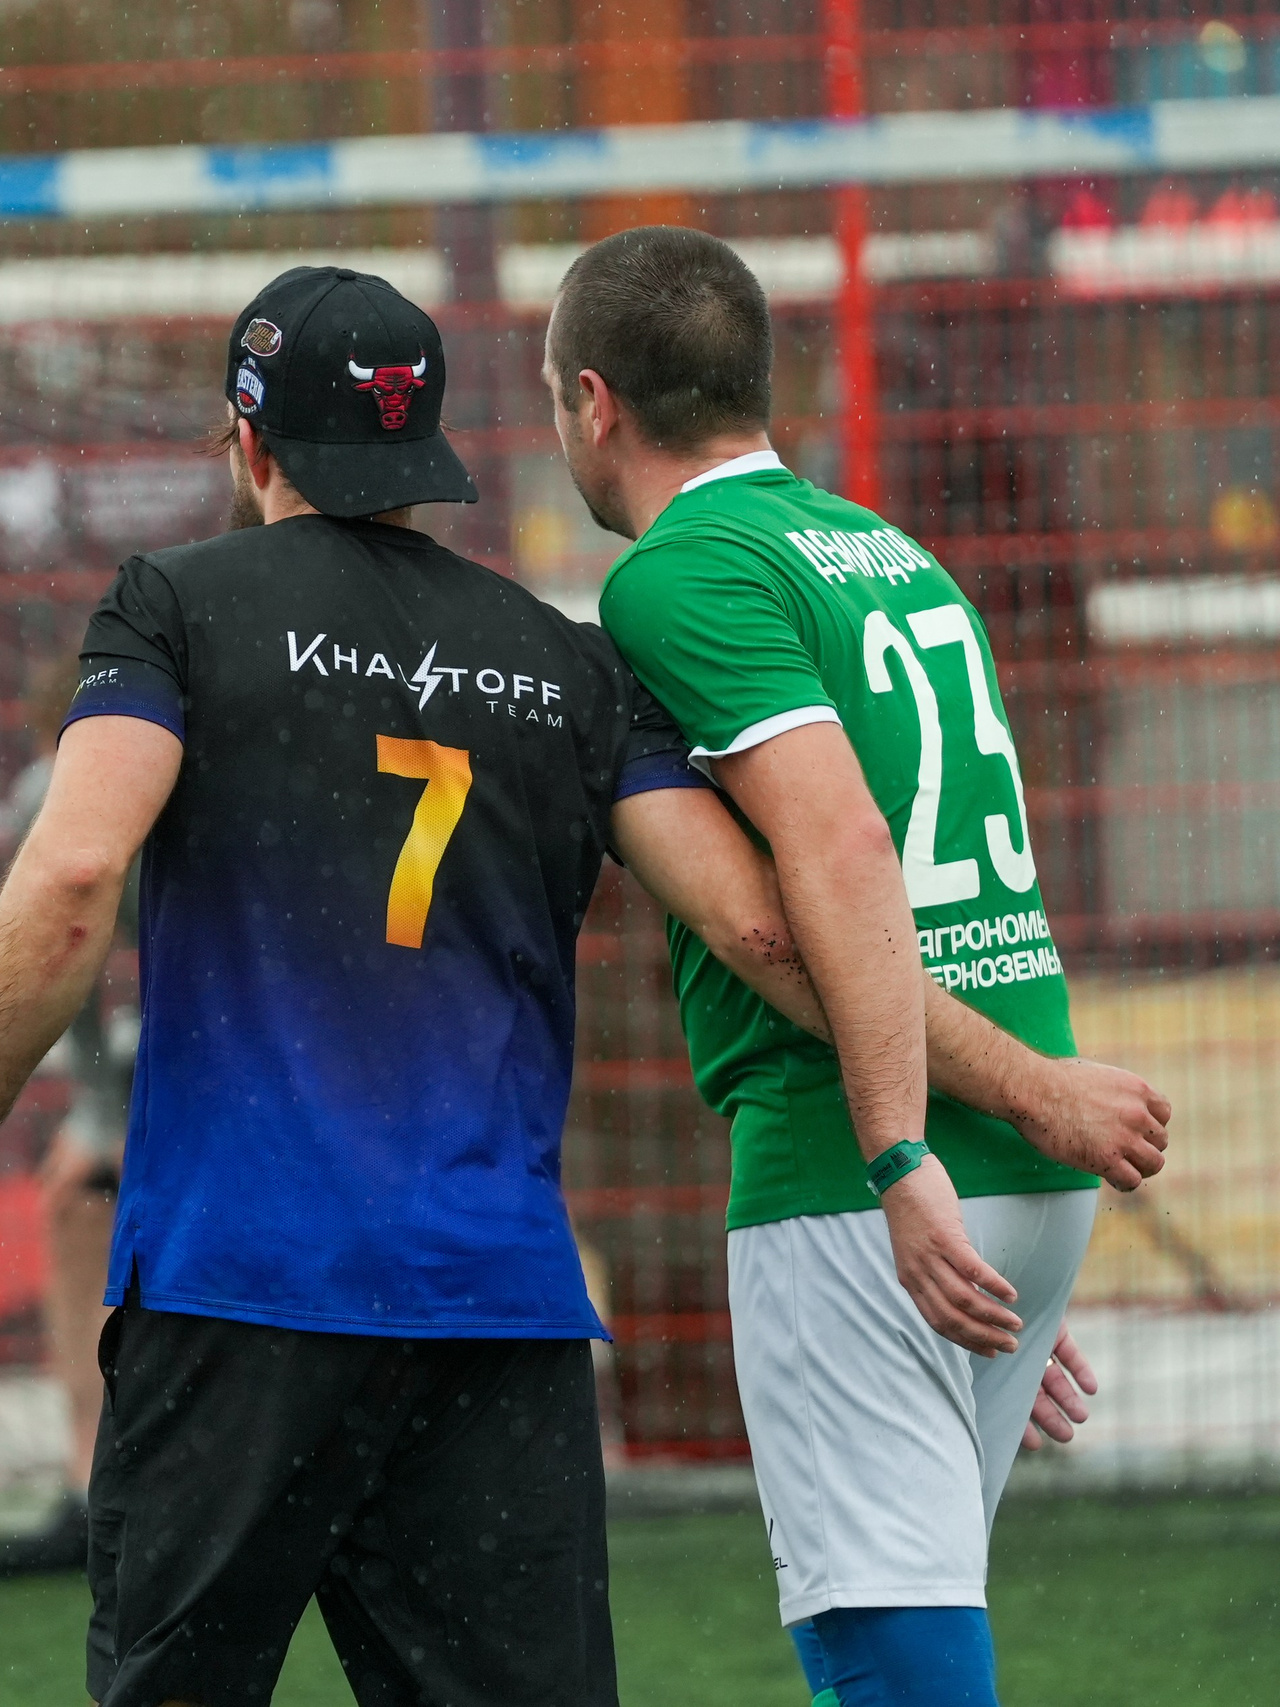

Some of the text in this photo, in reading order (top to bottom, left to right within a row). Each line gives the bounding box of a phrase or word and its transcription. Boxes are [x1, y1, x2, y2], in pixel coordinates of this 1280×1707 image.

[236, 368, 265, 405] EASTERN
[784, 528, 931, 586] ДЕМИДОВ
[486, 701, 563, 728] TEAM
[864, 604, 1037, 908] 23
[376, 734, 473, 949] 7
